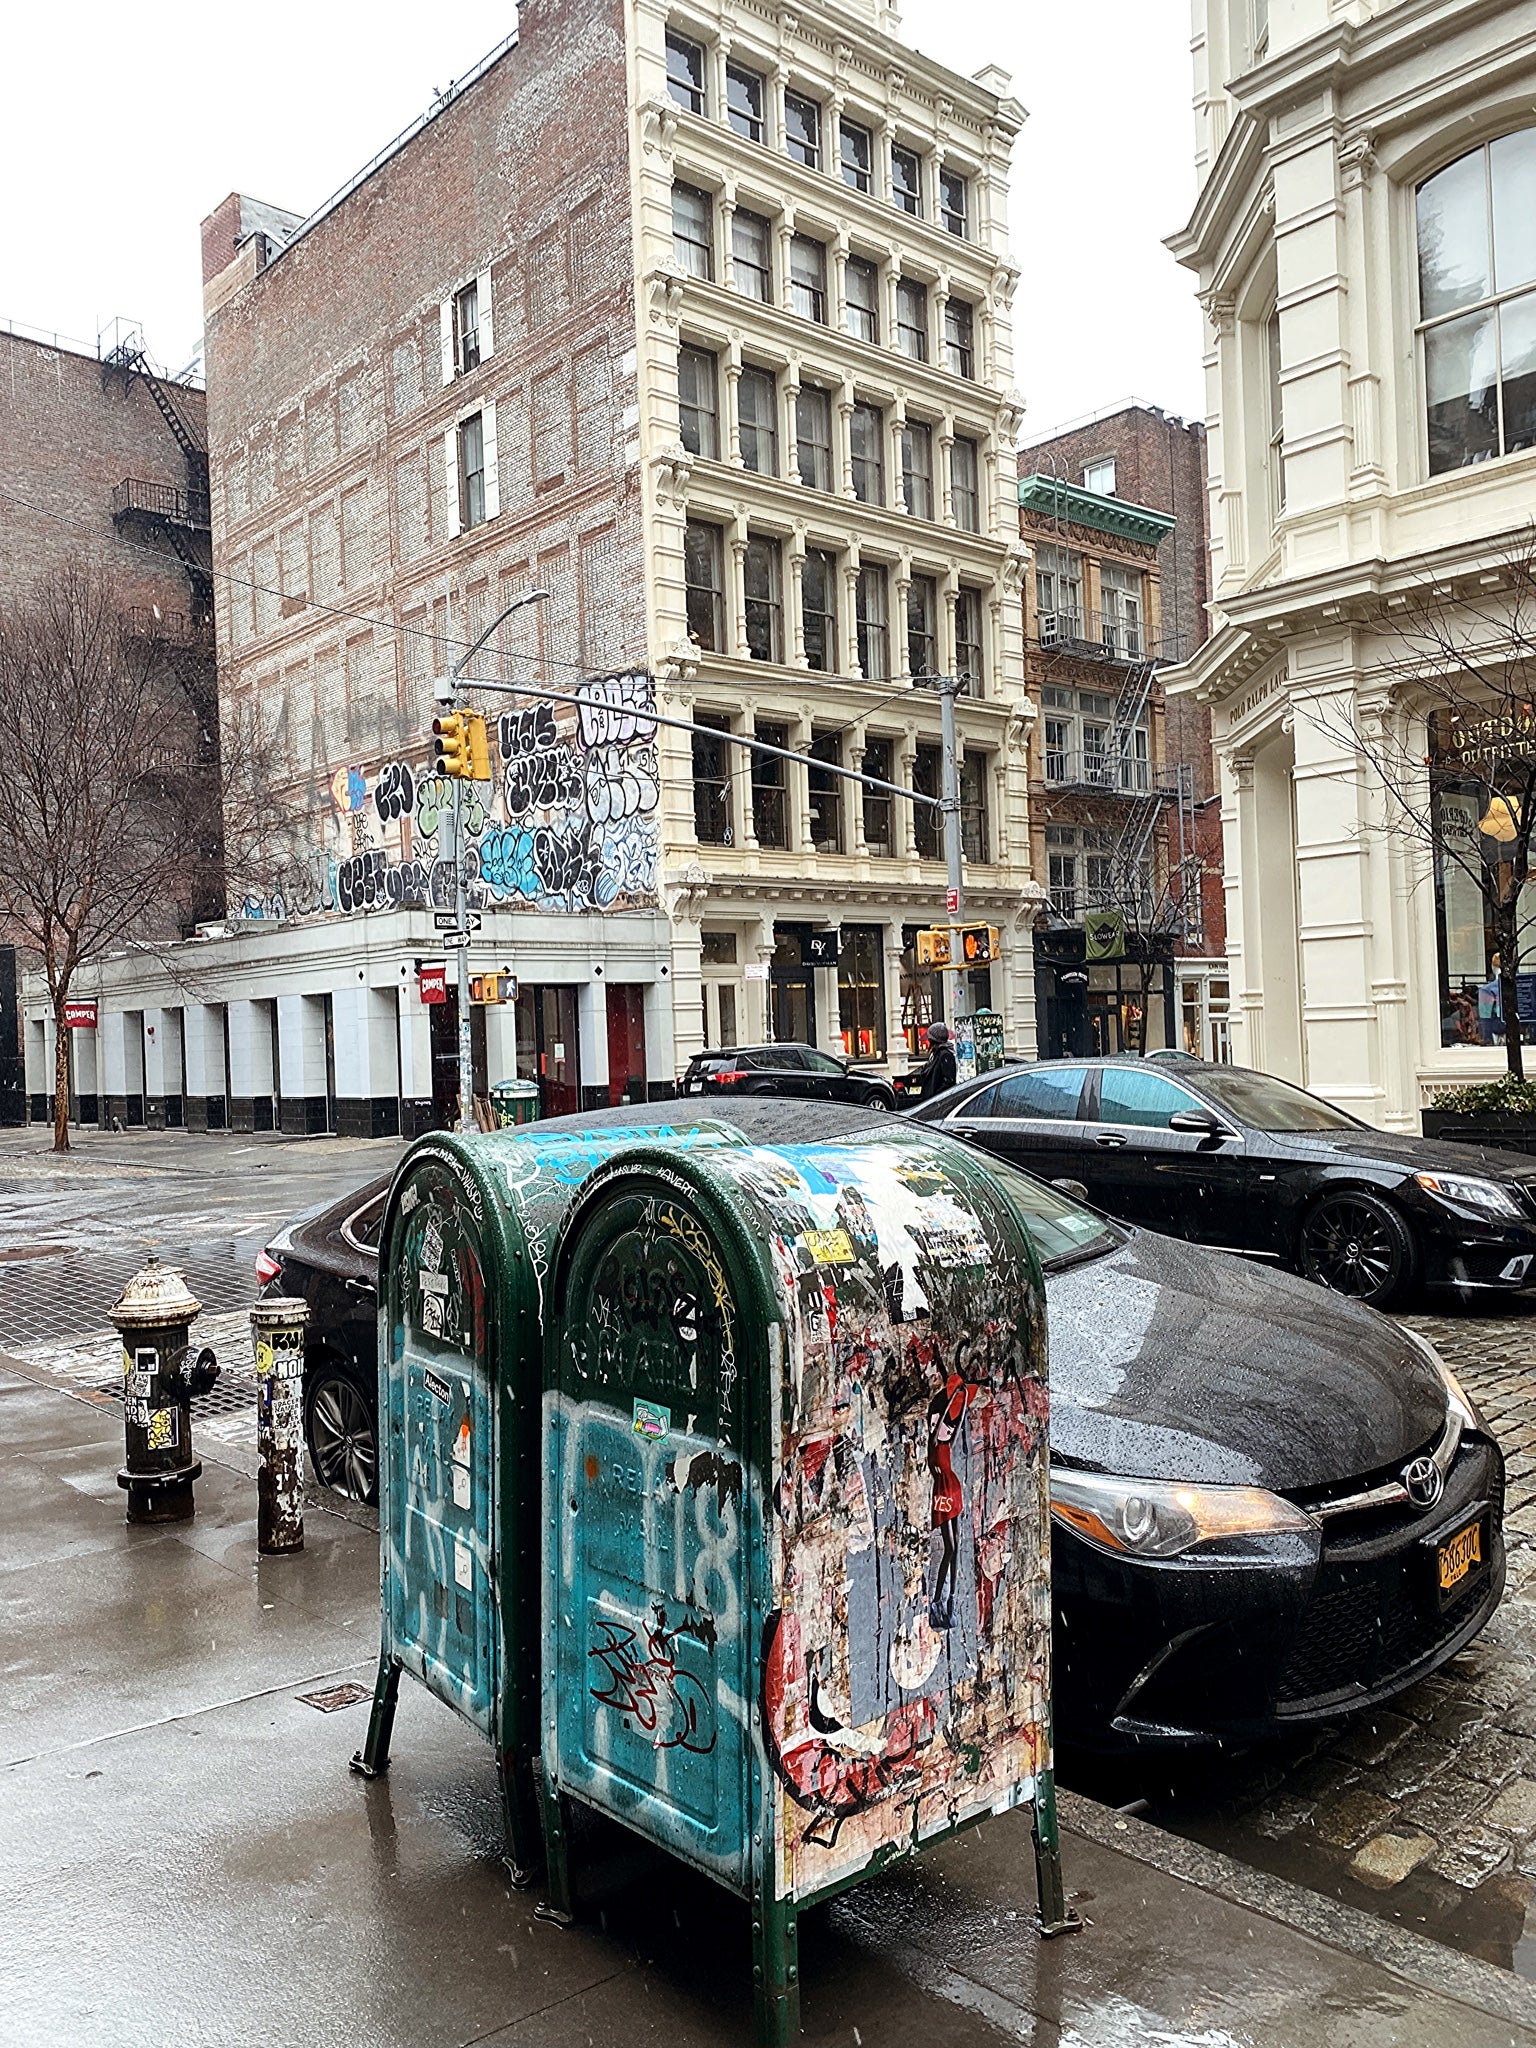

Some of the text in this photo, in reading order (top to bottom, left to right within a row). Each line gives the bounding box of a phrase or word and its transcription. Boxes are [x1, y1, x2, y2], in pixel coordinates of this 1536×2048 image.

[1230, 701, 1246, 725] POLO
[1247, 683, 1268, 712] RALPH
[1452, 716, 1536, 748] OUTDO
[438, 917, 453, 925] ONE
[1089, 929, 1120, 940] SLOWEAR
[422, 977, 444, 993] CAMPER
[65, 1009, 95, 1021] CAMPER
[425, 1373, 449, 1402] Alecton
[933, 1495, 953, 1513] YES
